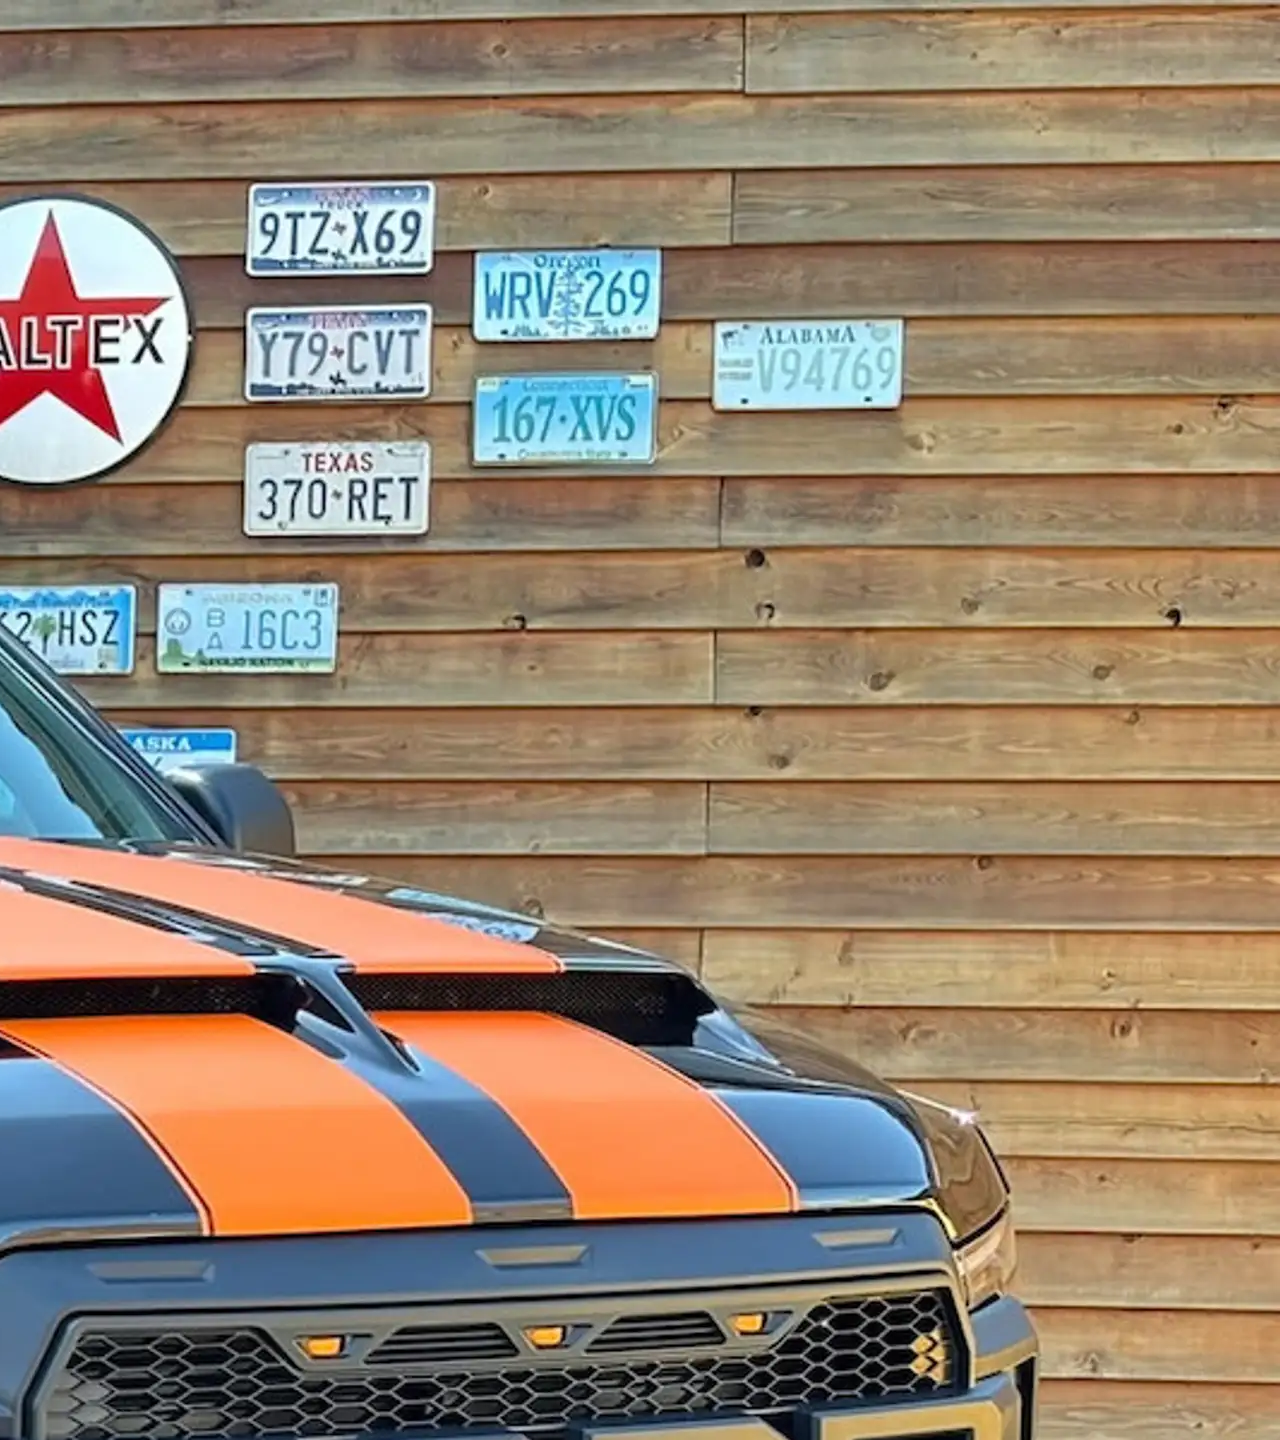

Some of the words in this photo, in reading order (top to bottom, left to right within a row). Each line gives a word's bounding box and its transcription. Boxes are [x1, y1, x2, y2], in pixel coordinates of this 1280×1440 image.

[760, 325, 856, 344] ALABAMA
[301, 452, 374, 473] TEXAS
[241, 609, 322, 650] 16C3
